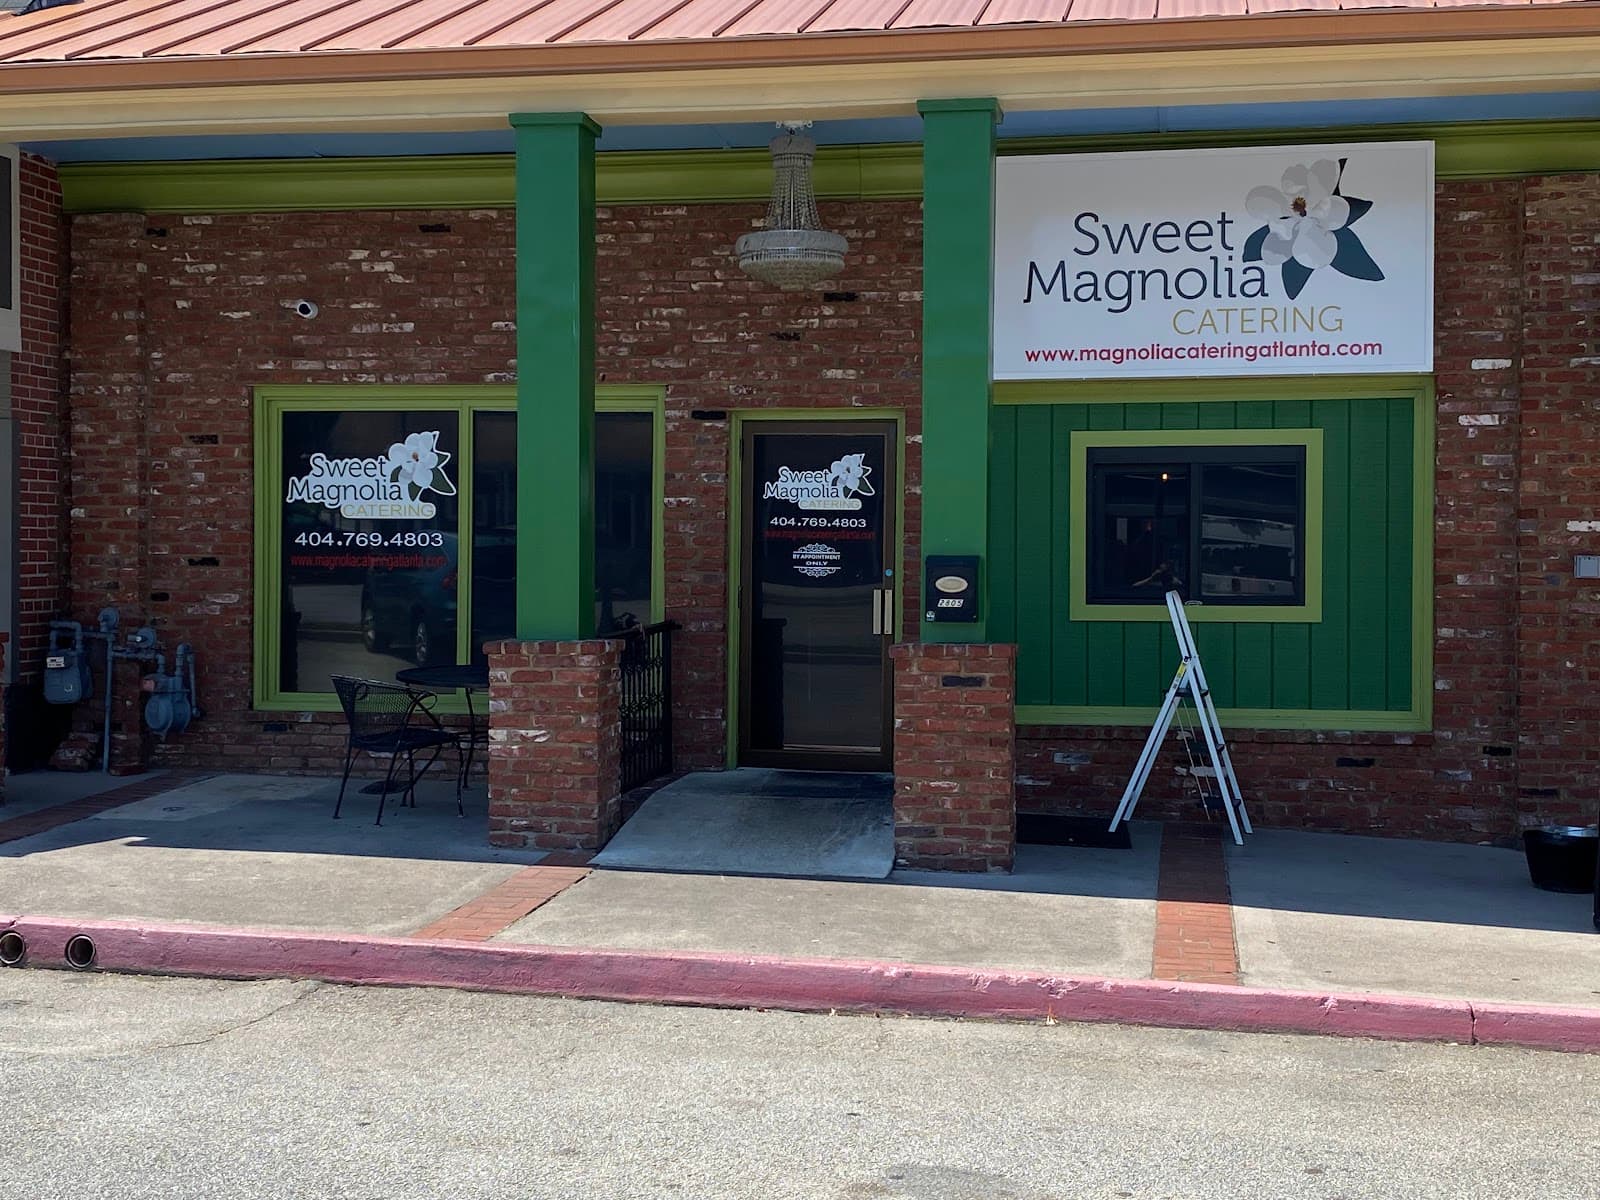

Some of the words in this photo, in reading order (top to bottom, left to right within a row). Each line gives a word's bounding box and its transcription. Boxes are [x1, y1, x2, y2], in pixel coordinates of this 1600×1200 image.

[1073, 211, 1234, 256] Sweet
[1023, 256, 1269, 313] Magnolia
[1172, 305, 1344, 336] CATERING
[1025, 340, 1383, 364] www.magnoliacateringatlanta.com
[311, 455, 387, 477] Sweet
[780, 468, 829, 483] Sweet
[288, 479, 403, 506] Magnolia
[764, 483, 840, 502] Magnolia
[342, 504, 434, 517] CATERING
[800, 500, 860, 509] CATERING
[769, 517, 867, 528] 404.769.4803
[294, 532, 443, 547] 404.769.4803
